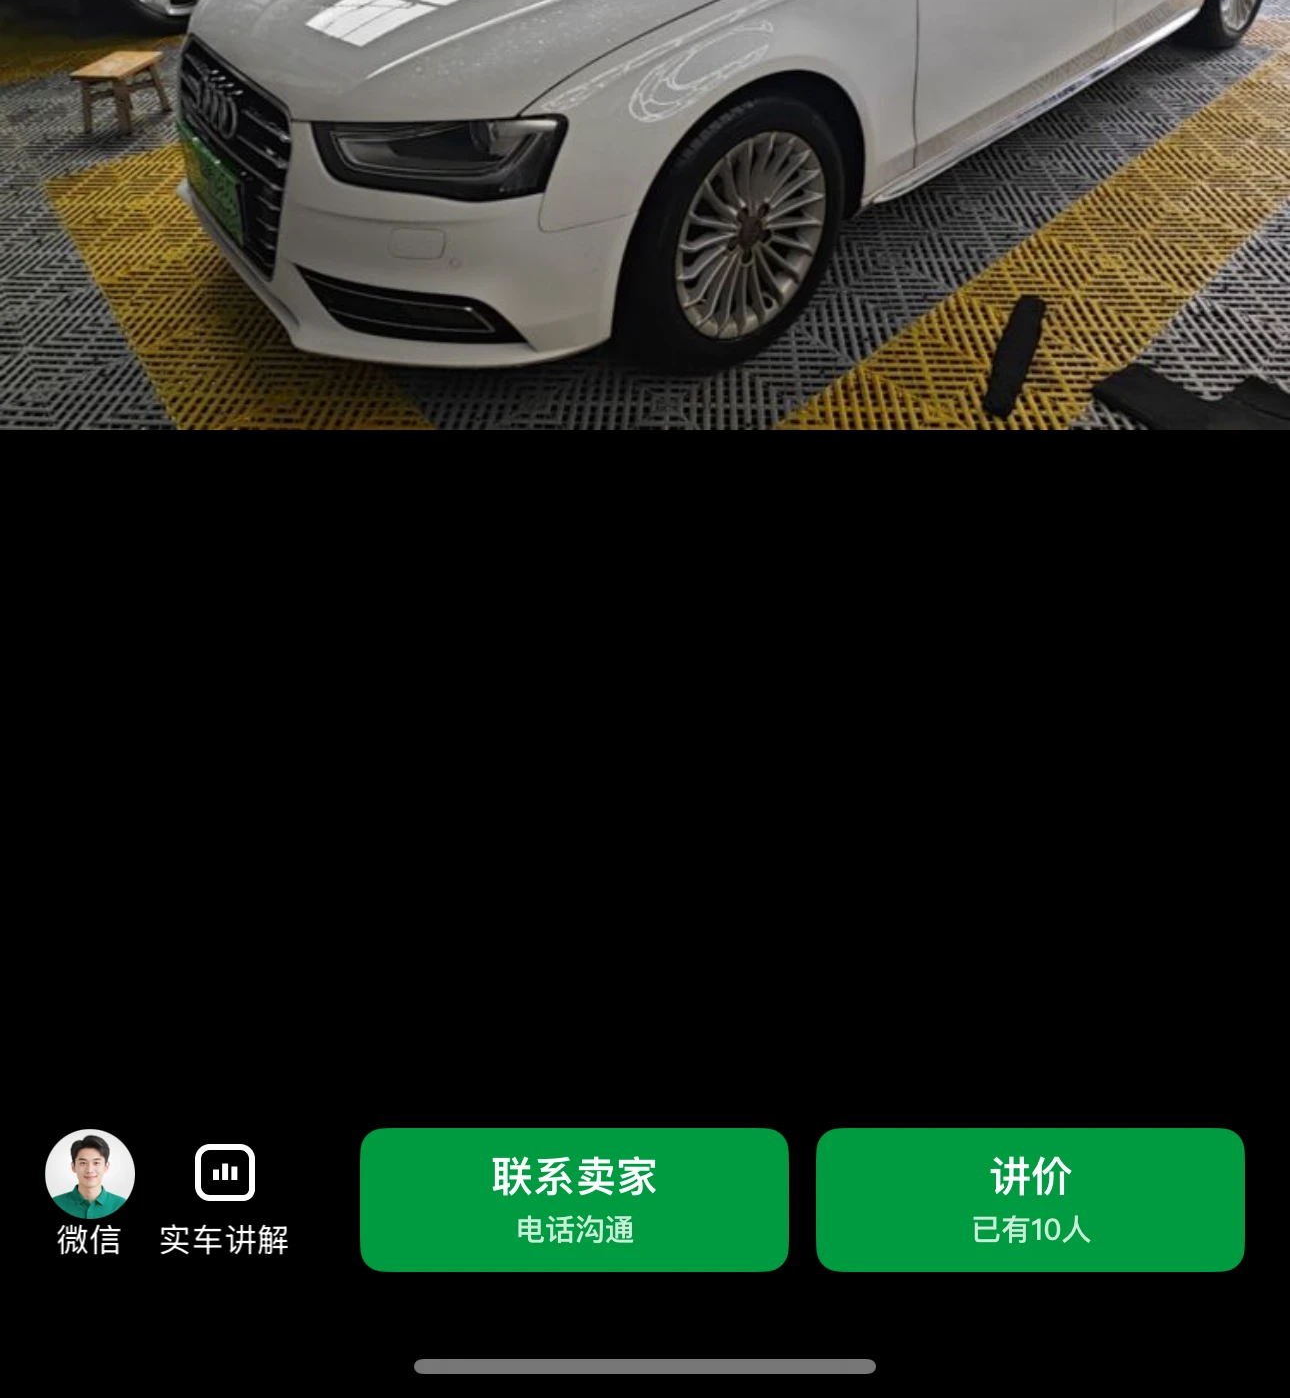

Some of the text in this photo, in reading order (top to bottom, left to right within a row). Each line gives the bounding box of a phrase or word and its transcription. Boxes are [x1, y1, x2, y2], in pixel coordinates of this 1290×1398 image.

[492, 1156, 656, 1196] 联系卖家
[990, 1156, 1072, 1196] 讲价
[57, 1224, 121, 1255] 微信
[160, 1224, 288, 1255] 实车讲解
[517, 1215, 634, 1244] 电话沟通
[972, 1215, 1091, 1244] 已有10人
